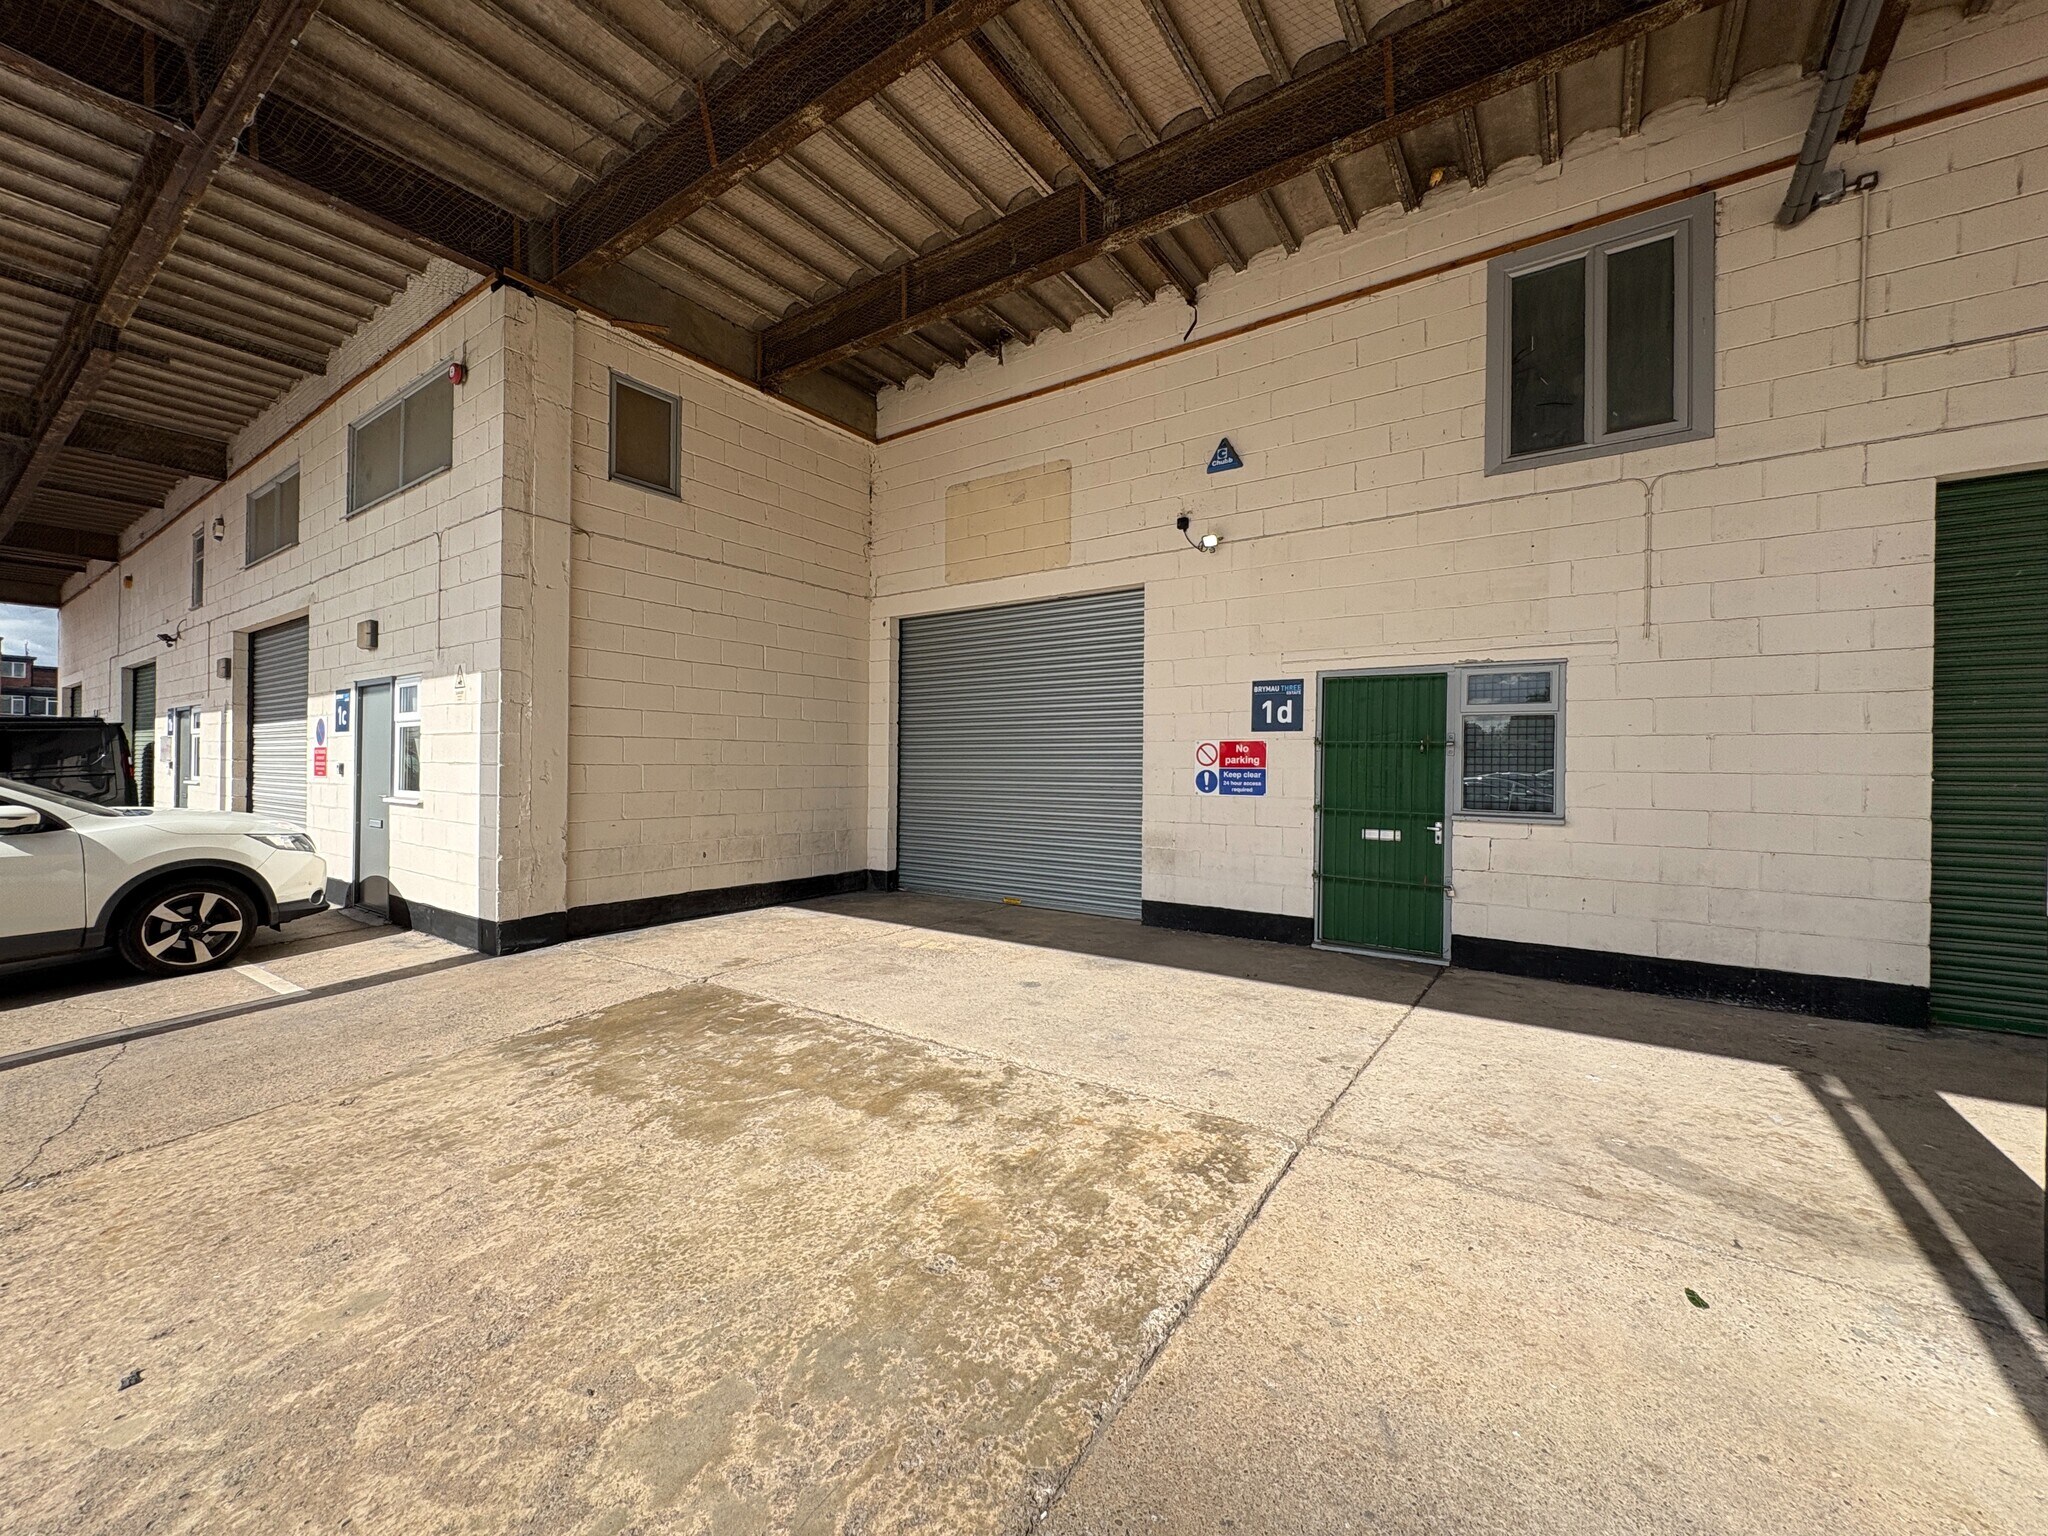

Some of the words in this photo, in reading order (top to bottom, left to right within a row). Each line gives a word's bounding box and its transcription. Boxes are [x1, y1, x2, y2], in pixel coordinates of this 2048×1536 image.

[1211, 457, 1233, 467] Chubb
[338, 706, 347, 725] 1c
[1261, 699, 1293, 724] 1d
[1235, 744, 1249, 753] No
[1225, 756, 1259, 766] parking
[1223, 771, 1242, 780] Keep
